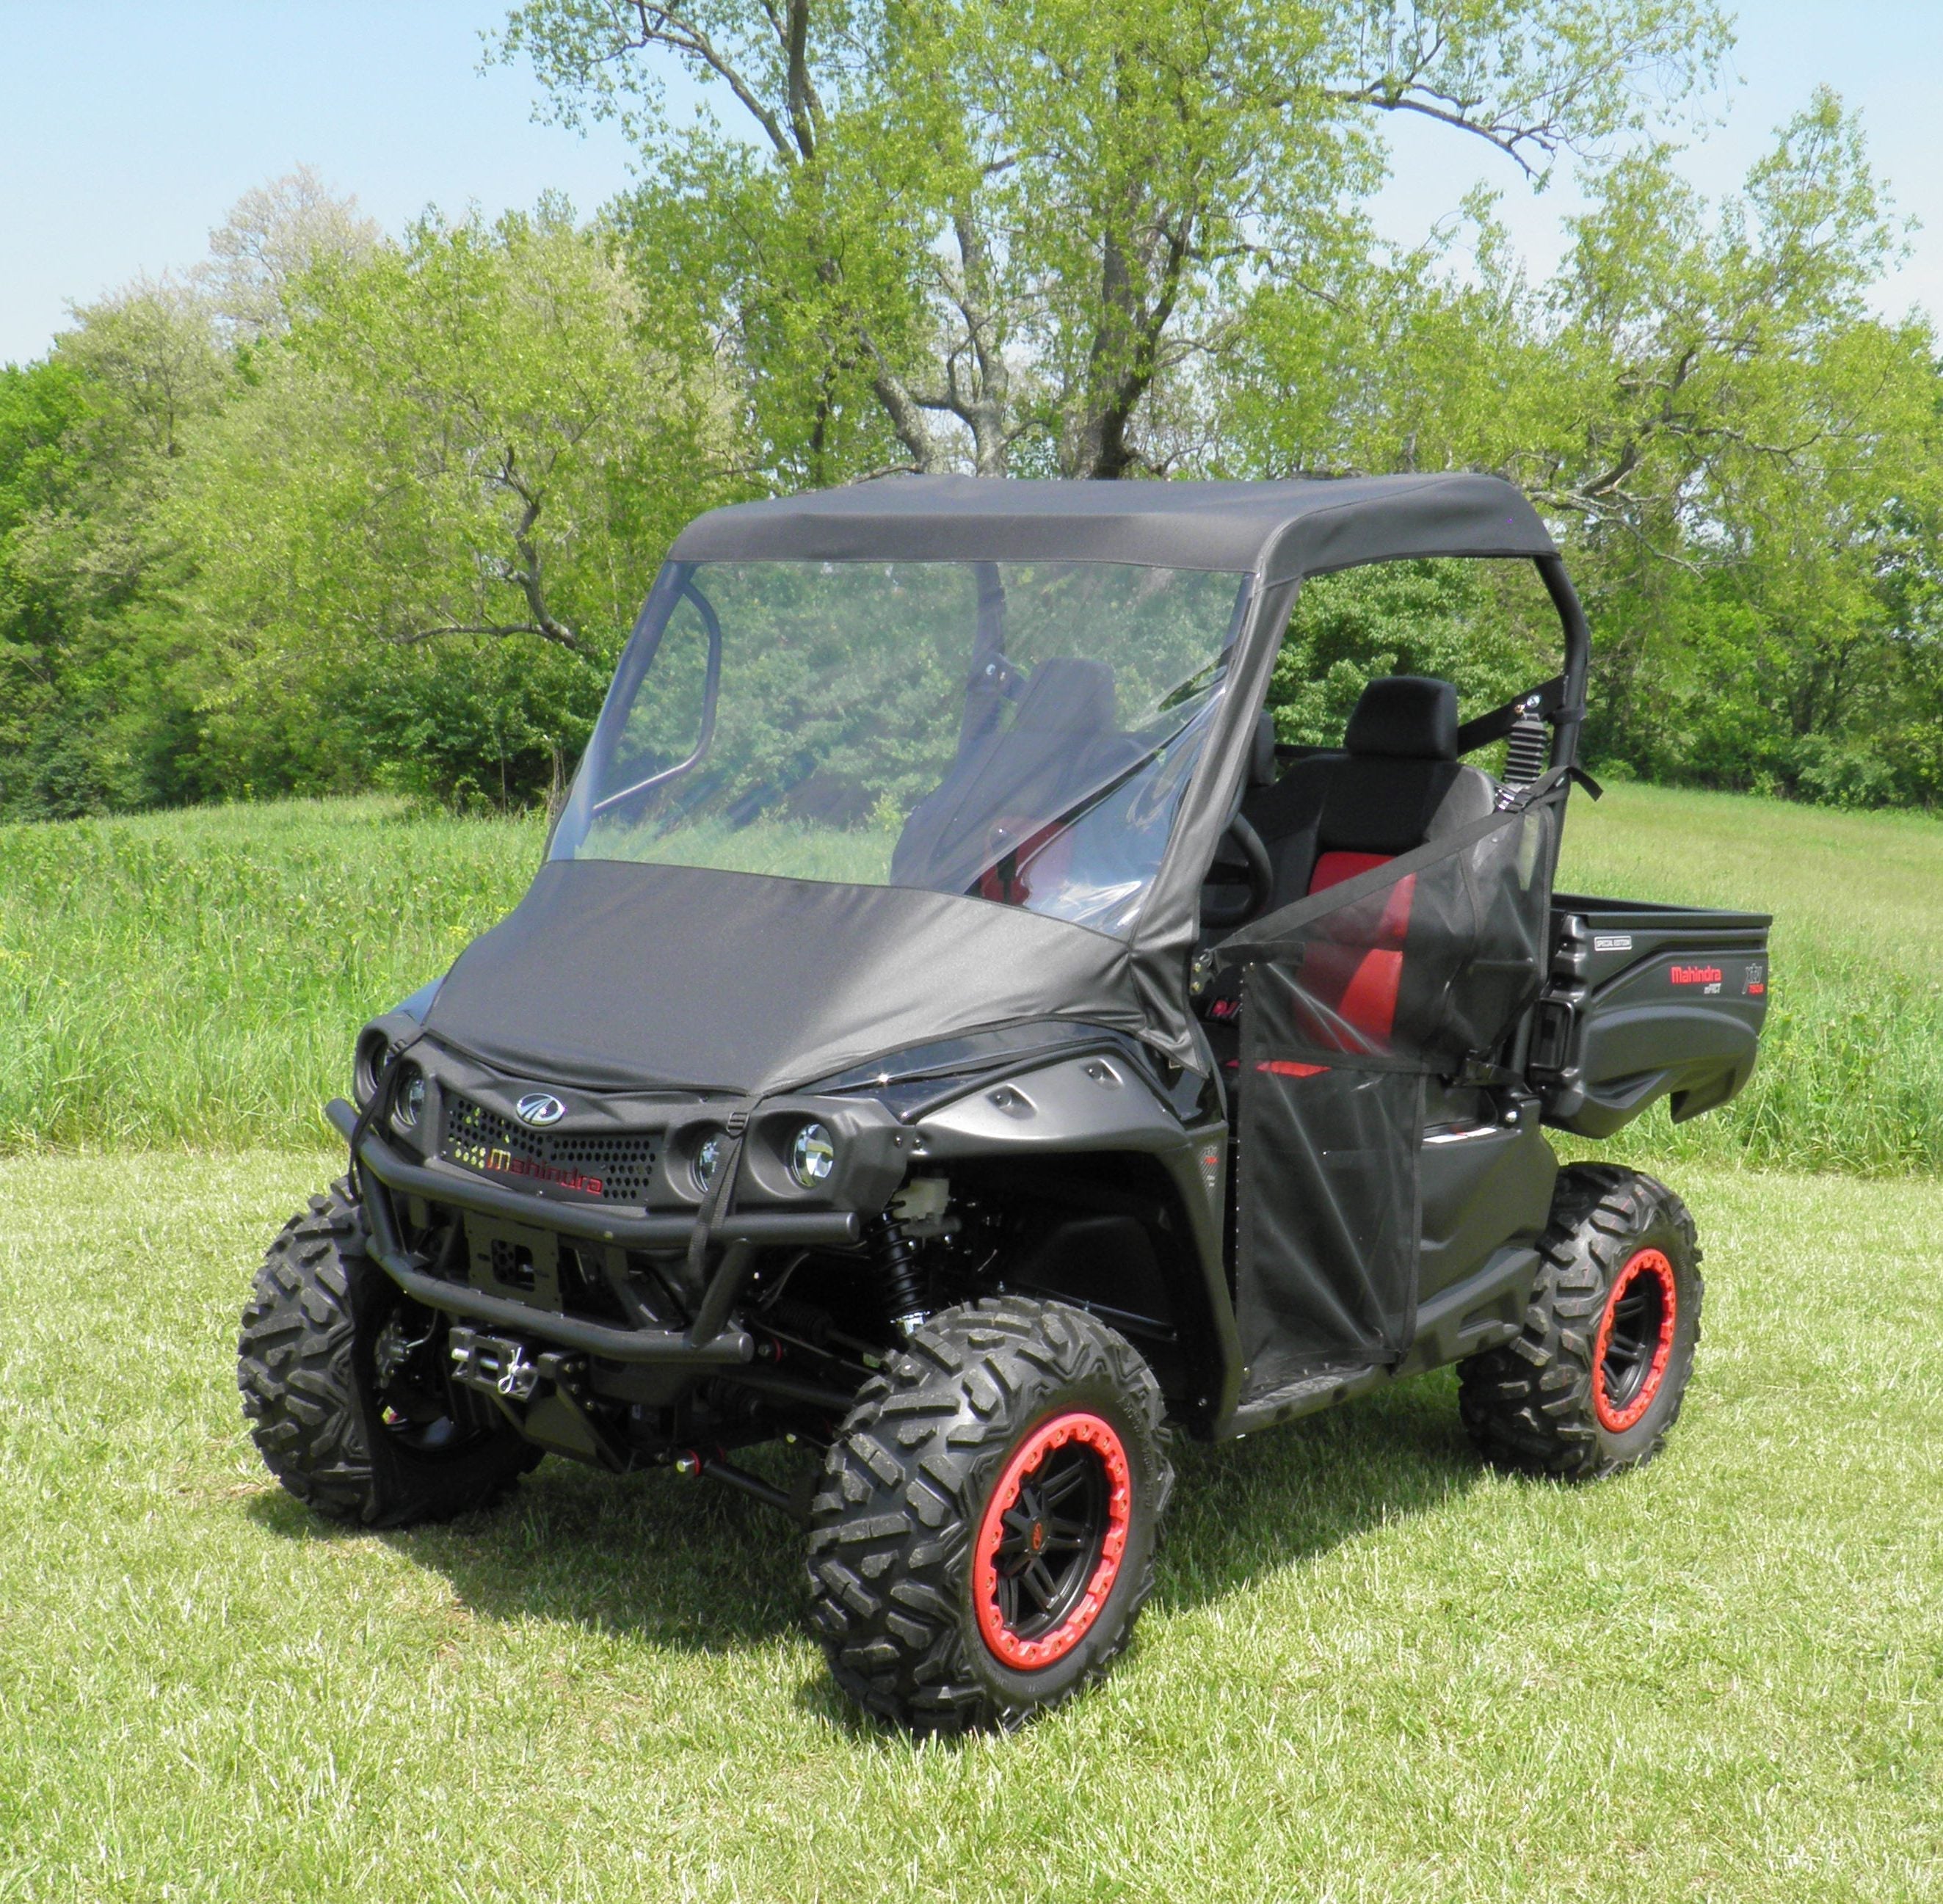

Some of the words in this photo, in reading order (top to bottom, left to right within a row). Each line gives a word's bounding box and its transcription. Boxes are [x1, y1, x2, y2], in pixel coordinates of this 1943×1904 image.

[1596, 940, 1613, 948] SPECIAL
[1613, 939, 1630, 947] EDITION
[1671, 965, 1721, 984] Mahindra
